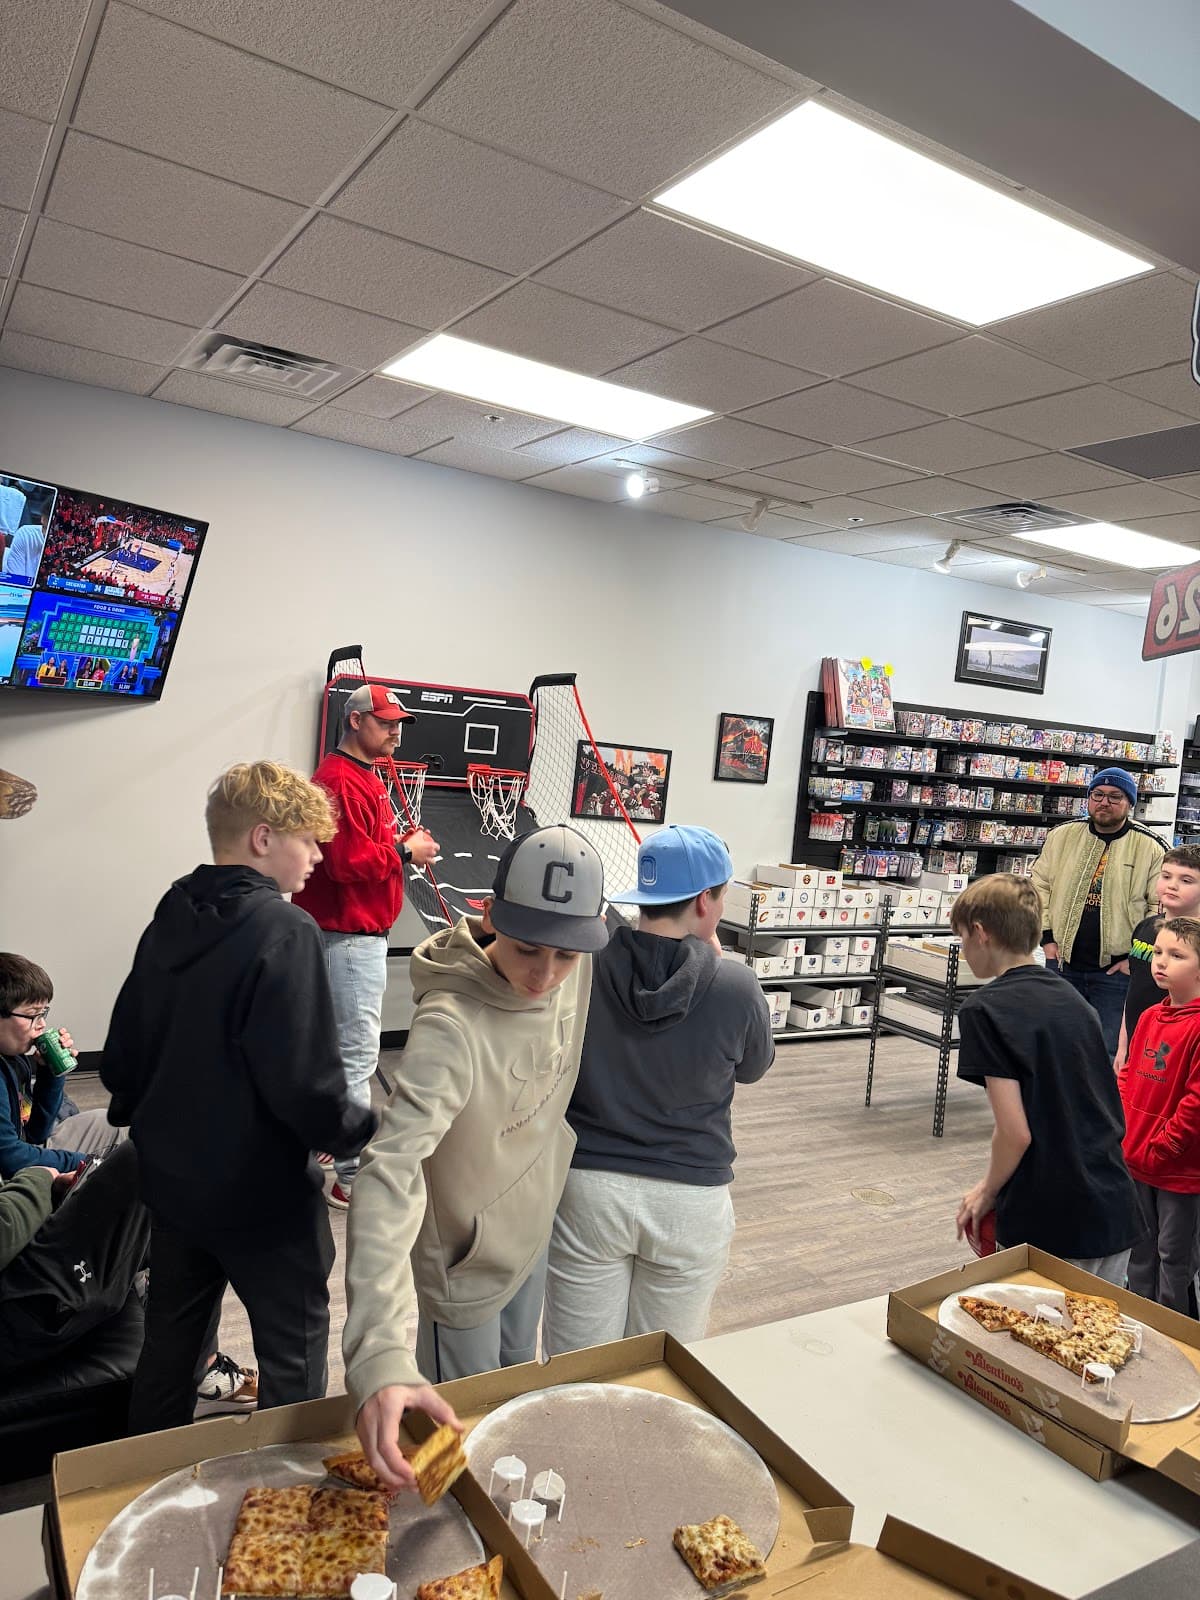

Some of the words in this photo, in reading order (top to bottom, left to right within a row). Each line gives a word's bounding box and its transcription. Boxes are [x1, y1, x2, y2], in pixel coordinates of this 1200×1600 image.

[421, 691, 453, 704] ESPN
[541, 861, 574, 904] C
[957, 1370, 1012, 1416] Valentino's
[965, 1350, 1024, 1393] Valentino's
